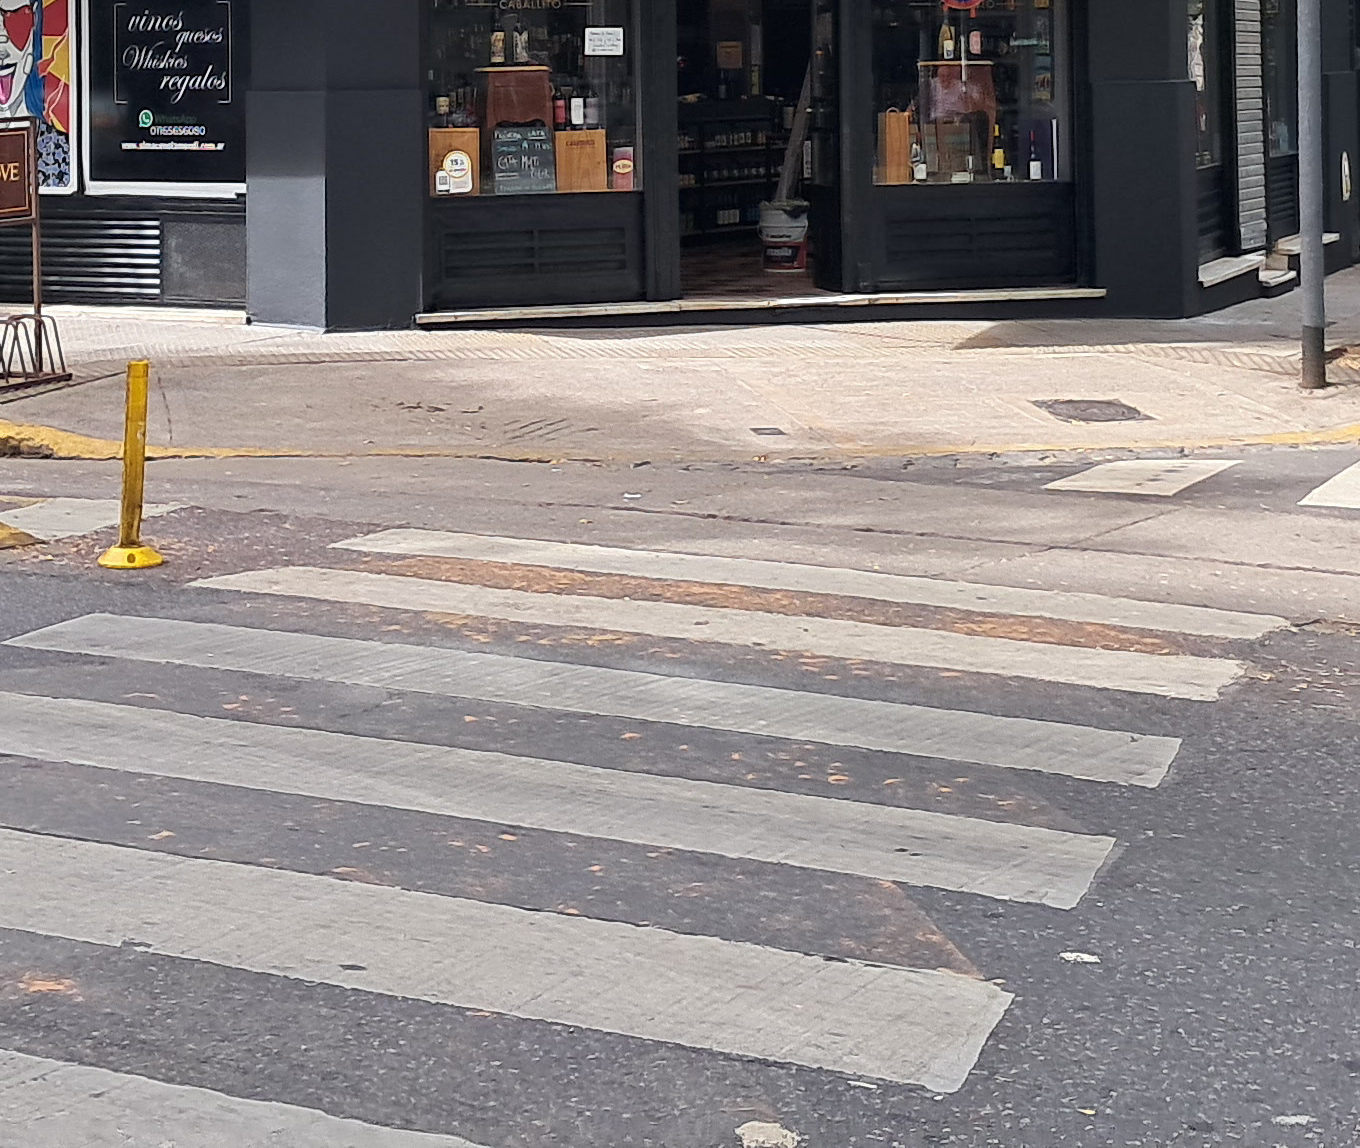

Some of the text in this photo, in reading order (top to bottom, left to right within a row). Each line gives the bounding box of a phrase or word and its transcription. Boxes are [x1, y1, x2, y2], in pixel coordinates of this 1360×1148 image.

[127, 9, 184, 32] vinos
[174, 27, 224, 53] quesos
[159, 64, 227, 105] regalos
